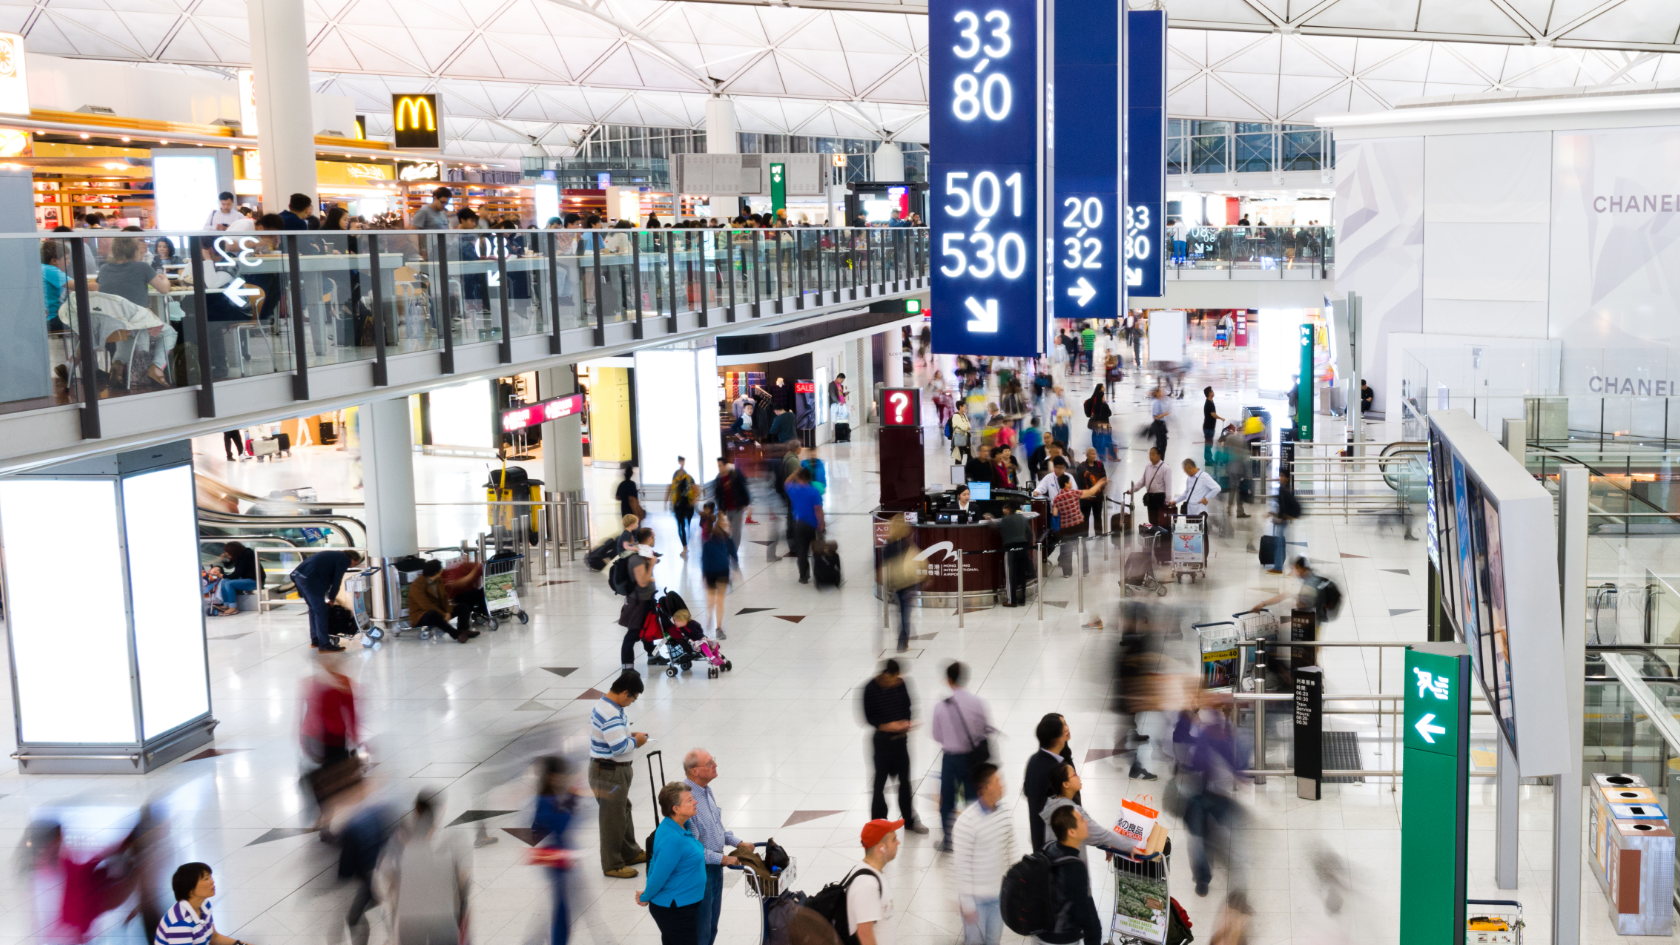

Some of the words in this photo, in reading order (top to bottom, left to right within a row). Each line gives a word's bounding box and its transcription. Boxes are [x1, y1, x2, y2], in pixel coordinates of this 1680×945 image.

[952, 10, 1011, 59] 33
[952, 73, 1012, 121] 80
[944, 171, 1021, 217] 501
[1063, 197, 1103, 228] 20
[940, 231, 1026, 279] 530
[1063, 238, 1102, 269] 32
